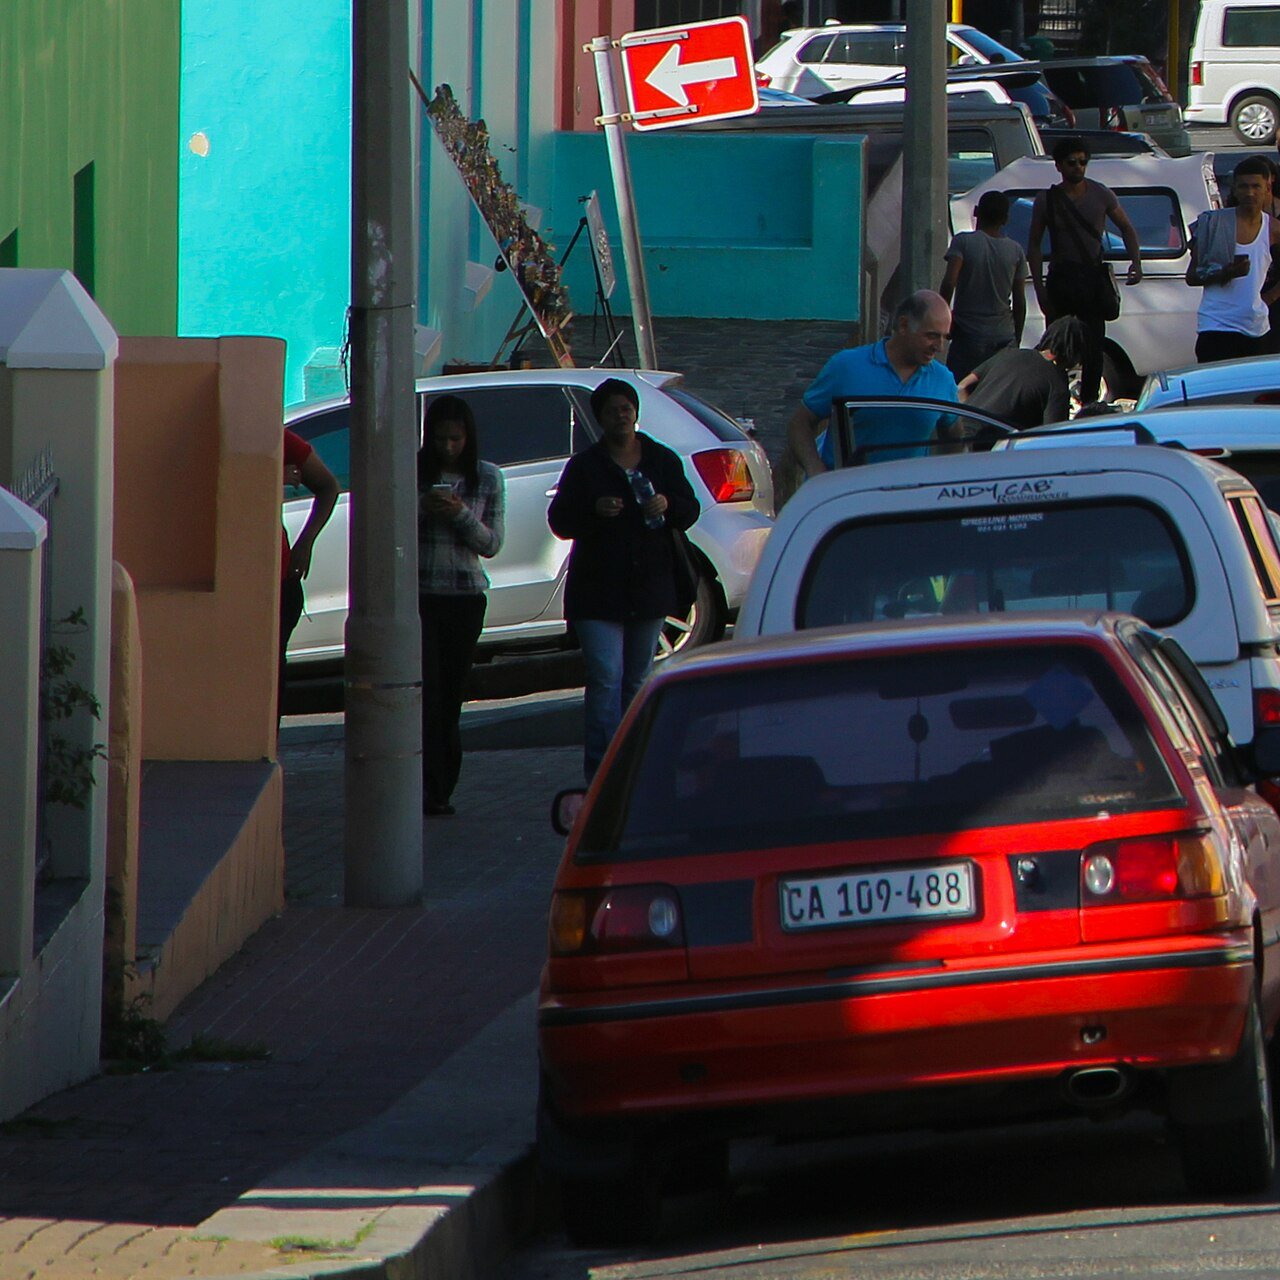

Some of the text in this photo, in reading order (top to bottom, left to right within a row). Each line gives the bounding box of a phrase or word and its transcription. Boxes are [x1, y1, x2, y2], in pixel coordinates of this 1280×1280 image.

[937, 483, 999, 500] ANDY
[787, 872, 961, 921] CA 109-488
